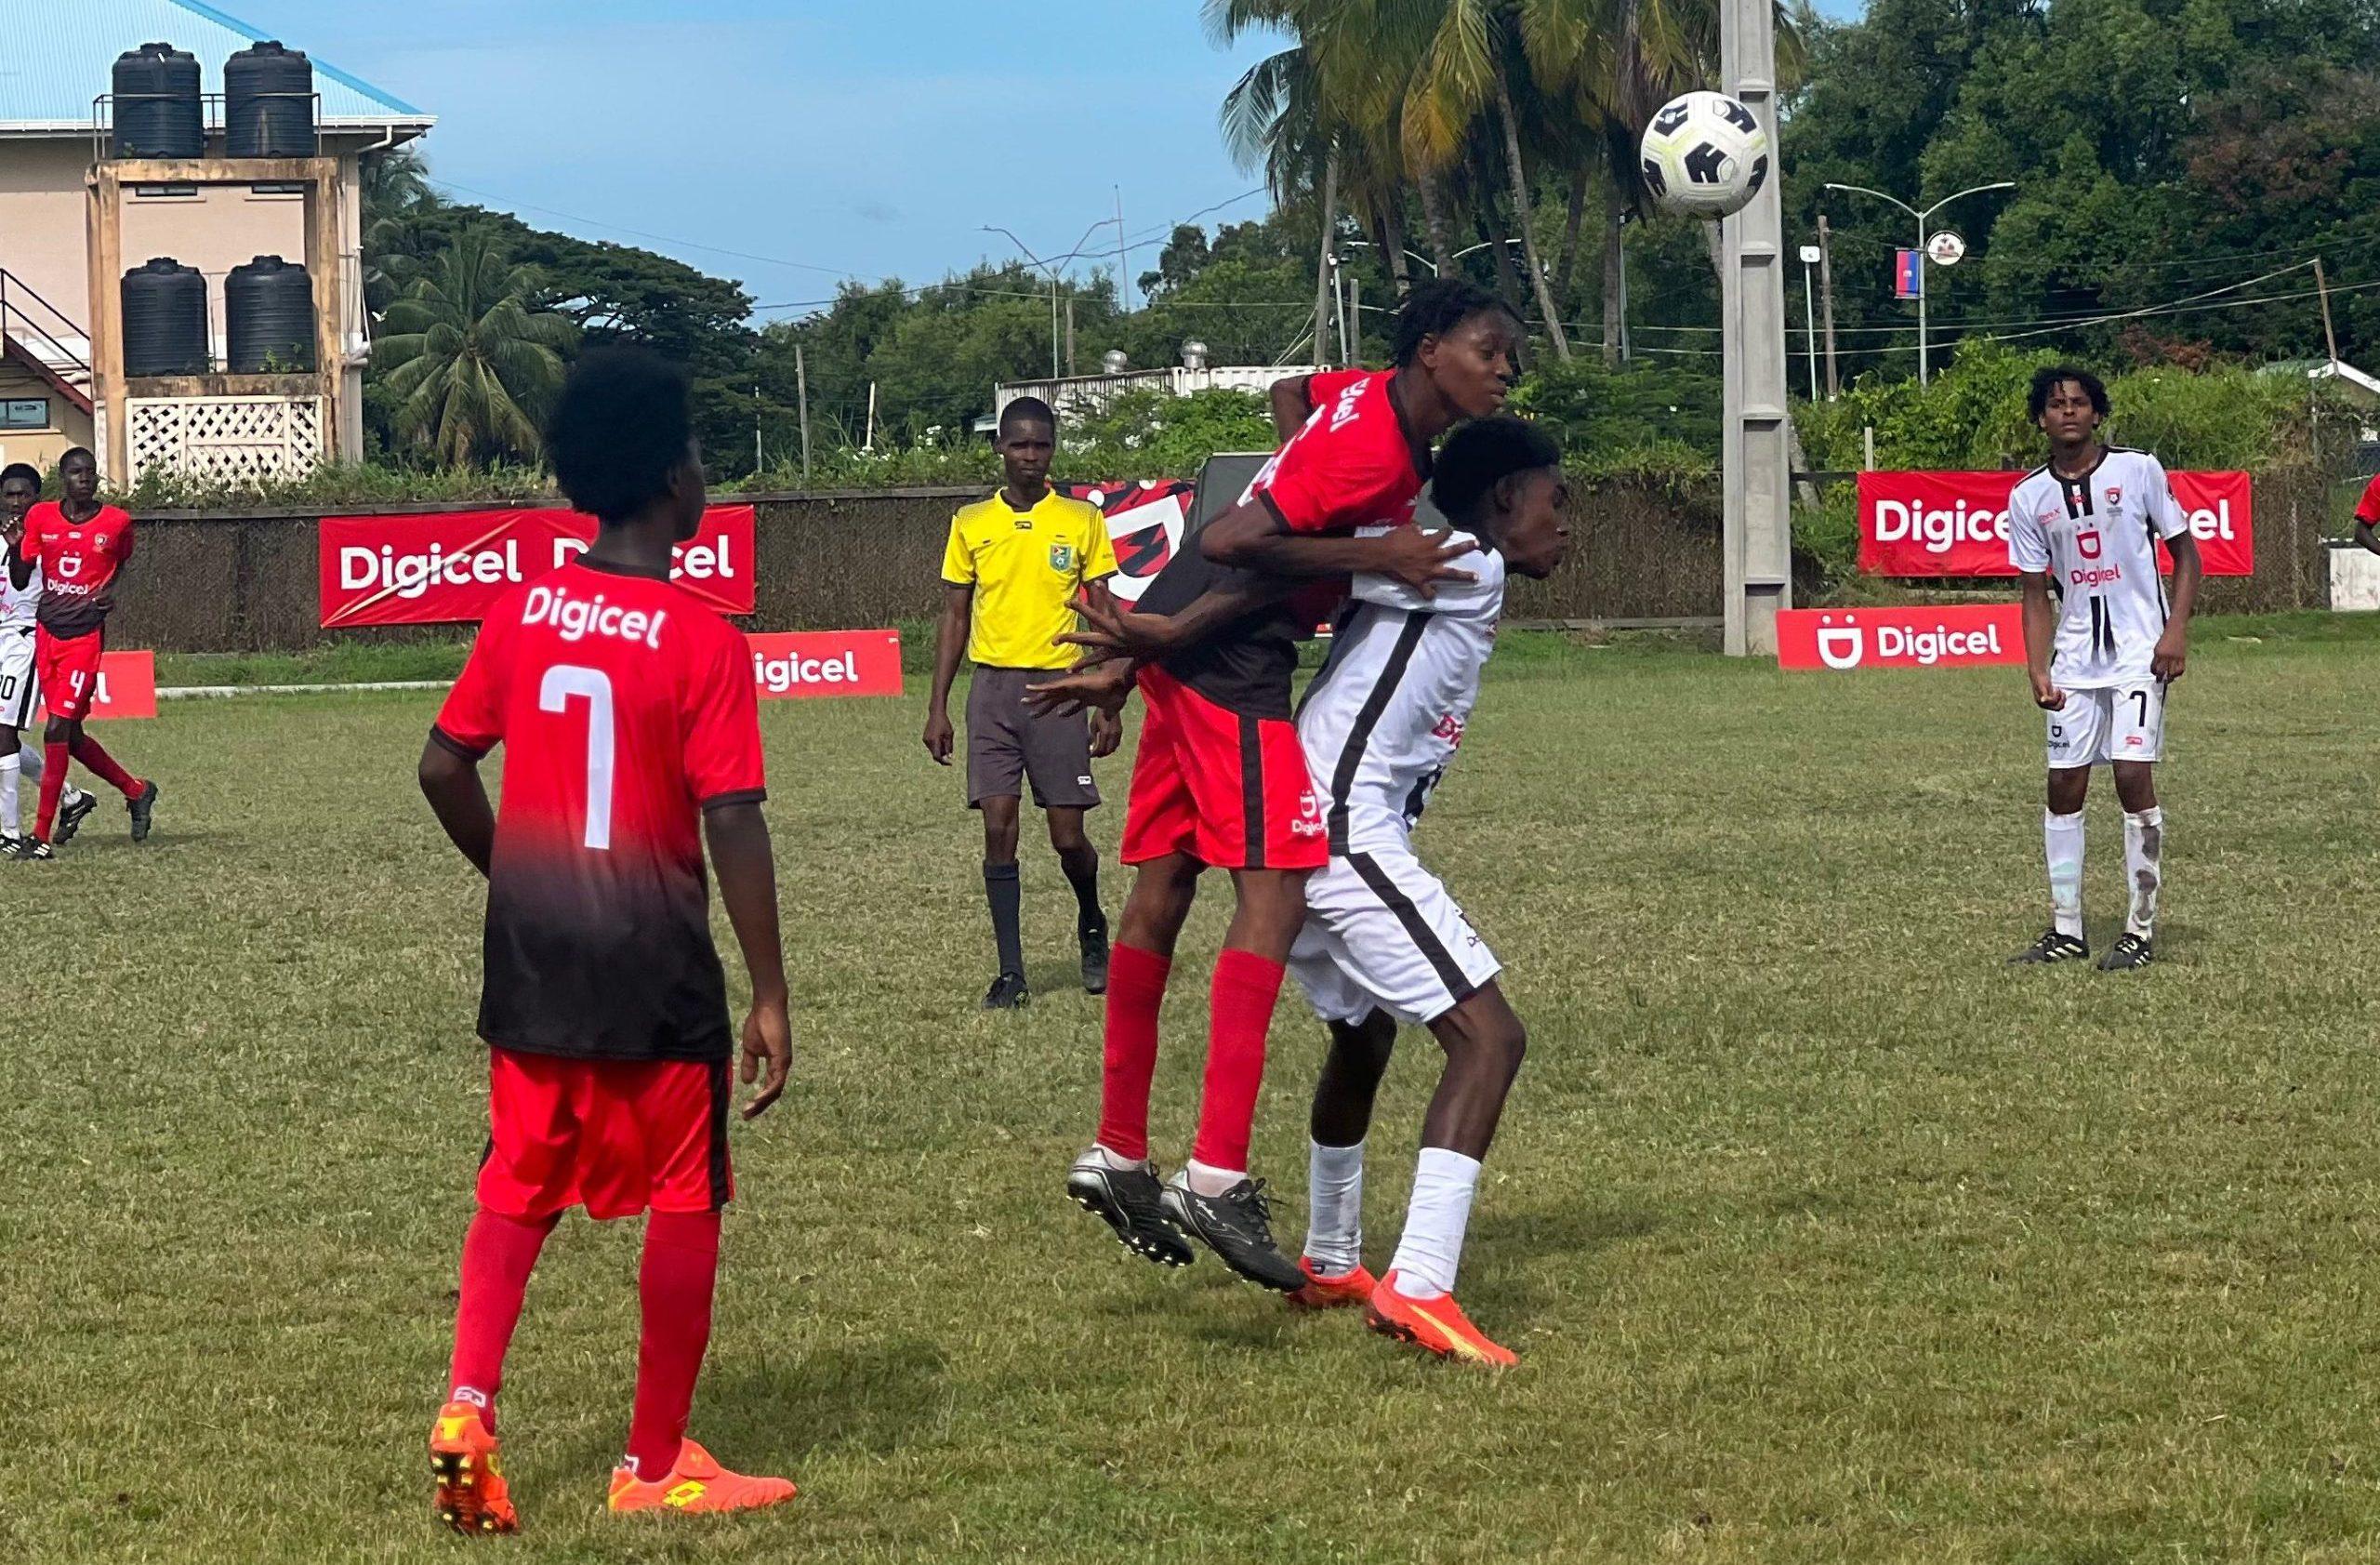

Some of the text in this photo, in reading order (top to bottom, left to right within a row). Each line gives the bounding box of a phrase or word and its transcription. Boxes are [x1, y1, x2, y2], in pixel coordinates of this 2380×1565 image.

[340, 539, 522, 598] Digicel
[522, 587, 666, 649] Digicel
[1877, 624, 2002, 664] Digicel
[70, 670, 86, 697] 4
[754, 651, 859, 693] igicel
[2129, 690, 2147, 727] 7
[539, 664, 615, 850] 7
